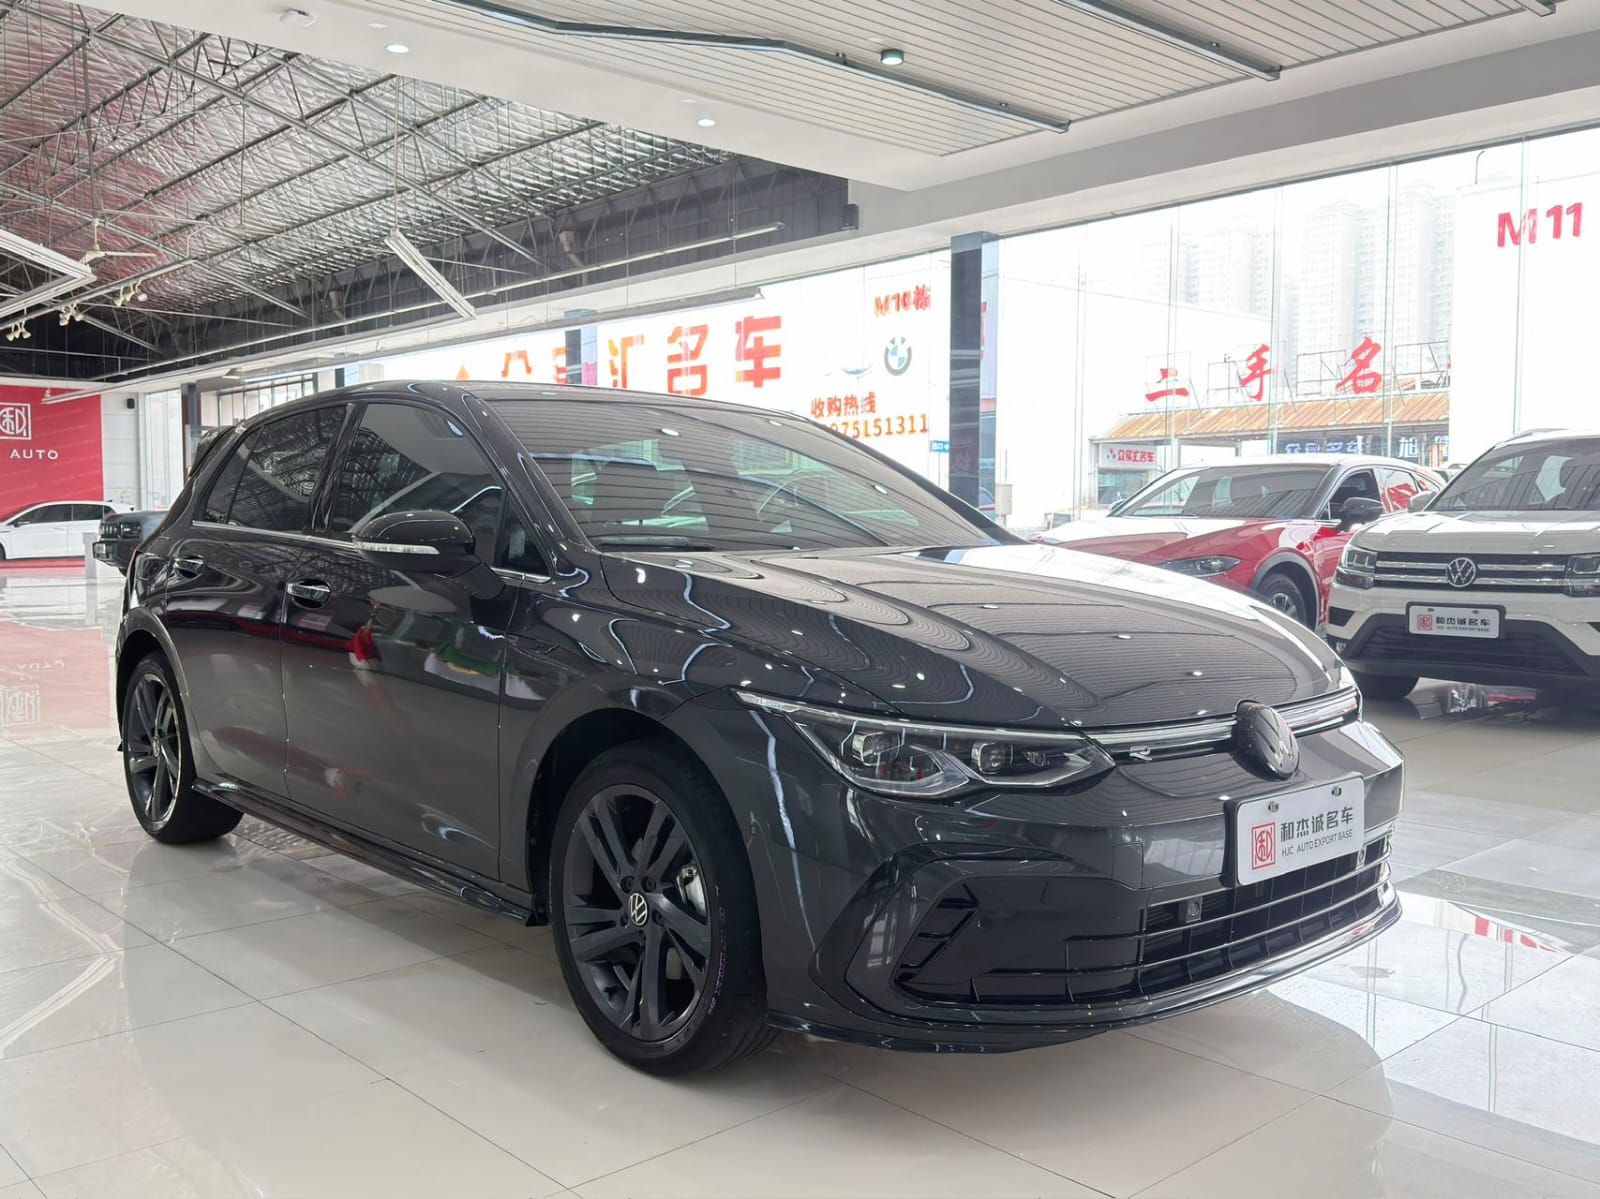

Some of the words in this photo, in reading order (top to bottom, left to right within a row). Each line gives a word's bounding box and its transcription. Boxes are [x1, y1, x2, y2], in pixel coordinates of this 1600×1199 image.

[1497, 202, 1583, 248] M11
[810, 391, 877, 419] 收购热线
[9, 449, 59, 460] AUTO
[1280, 806, 1353, 842] 和杰诚名车
[1281, 846, 1294, 857] HJC
[1296, 840, 1313, 853] AUTO
[1314, 832, 1337, 848] EXPORT
[1337, 829, 1353, 841] BASE
